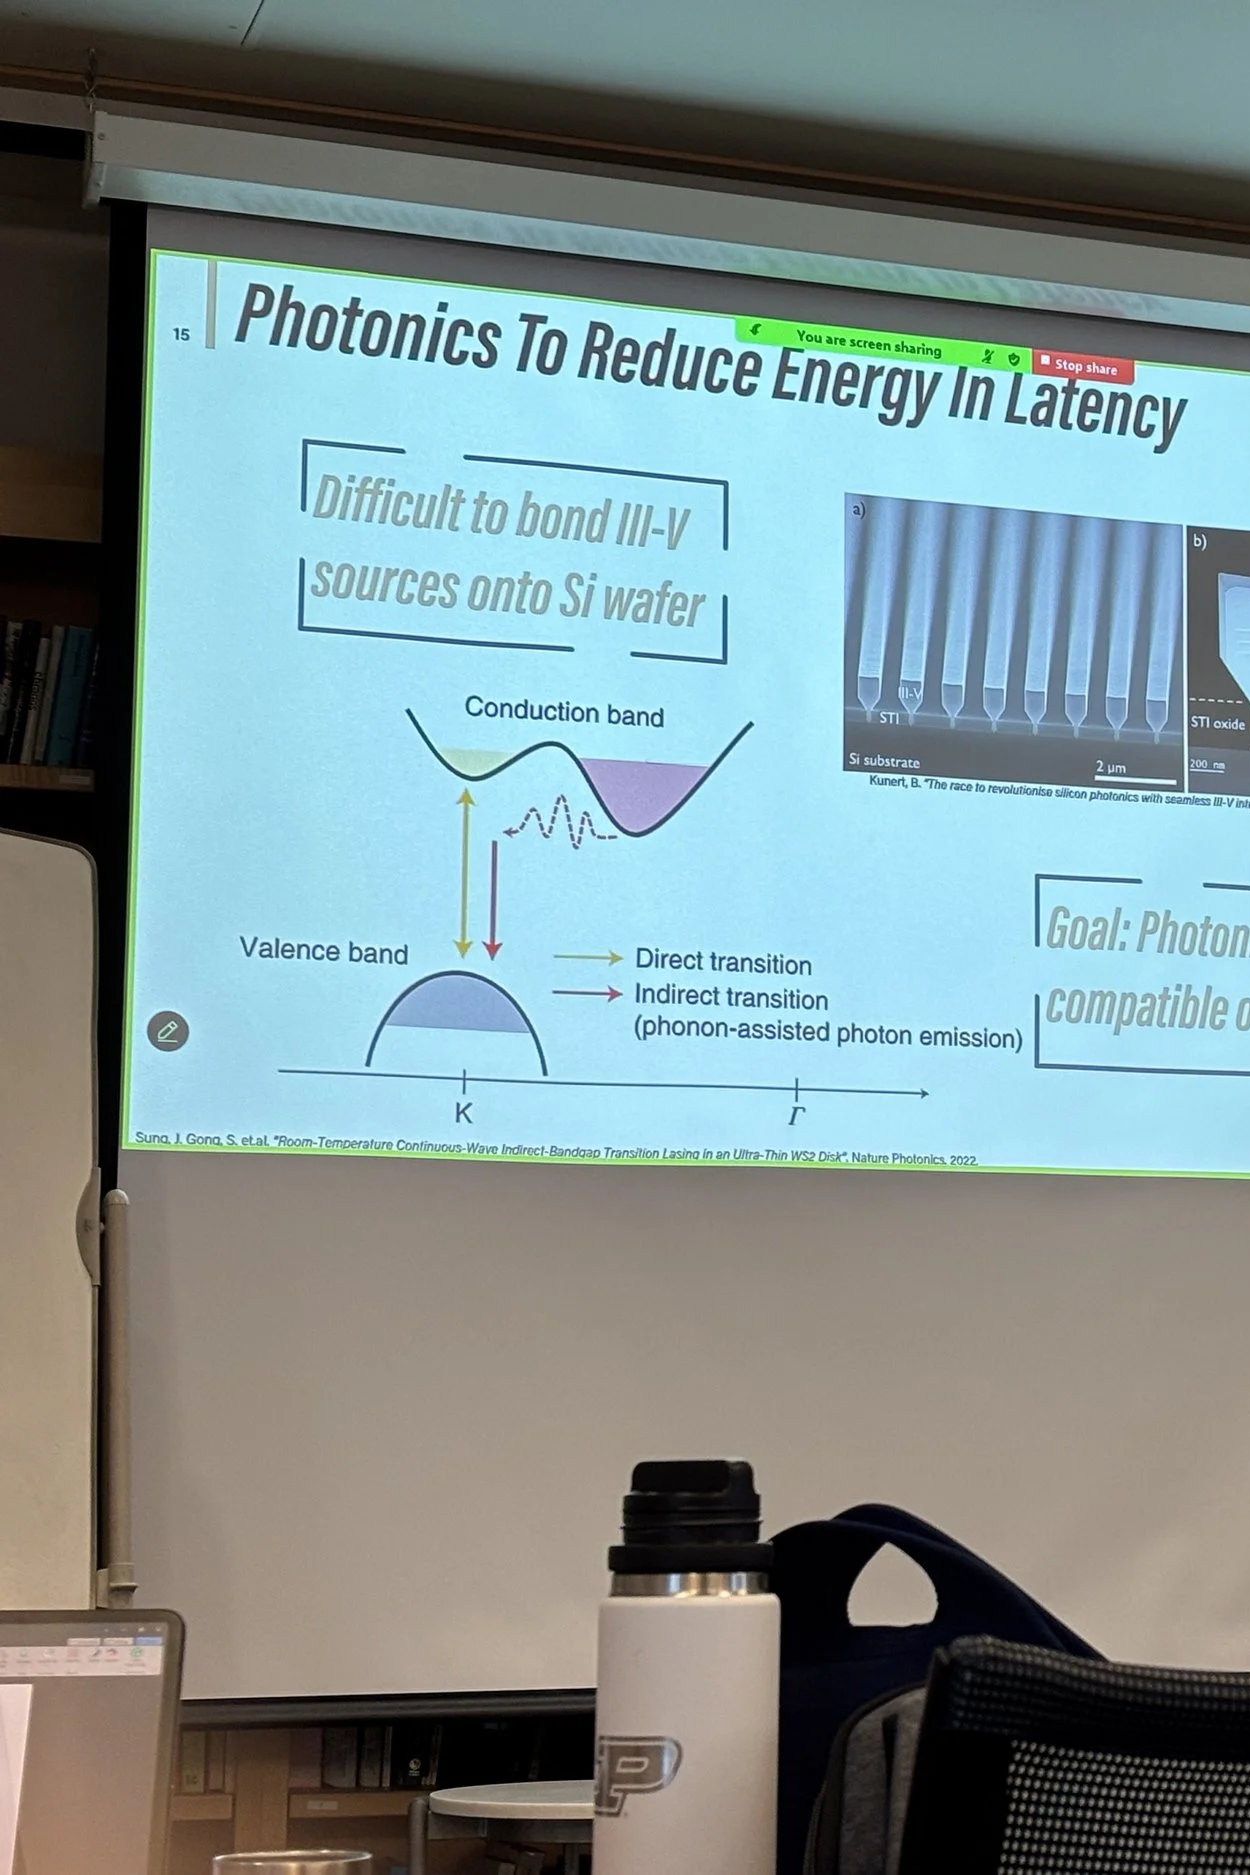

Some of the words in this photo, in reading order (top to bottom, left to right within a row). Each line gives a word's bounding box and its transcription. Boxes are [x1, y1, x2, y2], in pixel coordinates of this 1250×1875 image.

[173, 327, 190, 342] 15
[796, 329, 822, 346] You
[826, 335, 846, 347] are
[849, 337, 897, 353] screen
[899, 340, 943, 360] sharing
[235, 282, 502, 370] Photonics
[516, 312, 569, 377] To
[577, 320, 763, 397] Reduce
[771, 346, 943, 430] Energy
[948, 365, 995, 421] In
[1004, 373, 1188, 455] Latency
[1055, 358, 1083, 376] Stop
[1085, 361, 1118, 376] share
[312, 474, 466, 533] Difficult
[470, 491, 509, 535] to
[515, 491, 612, 544] bond
[615, 502, 691, 551] III-V
[852, 502, 866, 519] a)
[1193, 533, 1208, 551] b)
[311, 560, 460, 608] sources
[468, 571, 551, 616] onto
[559, 572, 599, 619] Si
[604, 584, 706, 628] wafer
[465, 695, 600, 723] Conduction
[607, 704, 665, 728] band
[879, 712, 900, 725] STI
[1190, 716, 1210, 730] STI
[1213, 718, 1246, 732] oxide
[849, 753, 861, 766] Si
[863, 754, 921, 769] substrate
[1096, 760, 1104, 772] 2
[1190, 759, 1208, 770] 200
[869, 774, 908, 789] Kunert,
[910, 776, 922, 788] B.
[950, 781, 973, 792] race
[975, 782, 986, 793] to
[988, 783, 1053, 797] revolutionise
[1055, 786, 1087, 799] silicon
[1089, 789, 1138, 804] photonics
[1141, 792, 1163, 804] with
[1165, 795, 1211, 807] seamless
[1046, 906, 1130, 952] Goal:
[240, 936, 341, 963] Valence
[348, 942, 409, 966] band
[636, 947, 704, 972] Direct
[710, 951, 813, 976] transition
[635, 982, 721, 1007] Indirect
[726, 986, 829, 1011] transition
[1046, 983, 1228, 1036] compatible
[634, 1013, 830, 1043] (phonon-assisted
[836, 1023, 913, 1048] photon
[919, 1027, 1024, 1053] emission)
[455, 1102, 473, 1124] K
[396, 1139, 498, 1155] Continuous-Wave
[603, 1147, 659, 1159] Transition
[702, 1149, 713, 1160] in
[716, 1151, 730, 1160] an
[733, 1149, 788, 1161] Ultra-Thin
[852, 1152, 888, 1164] Nature
